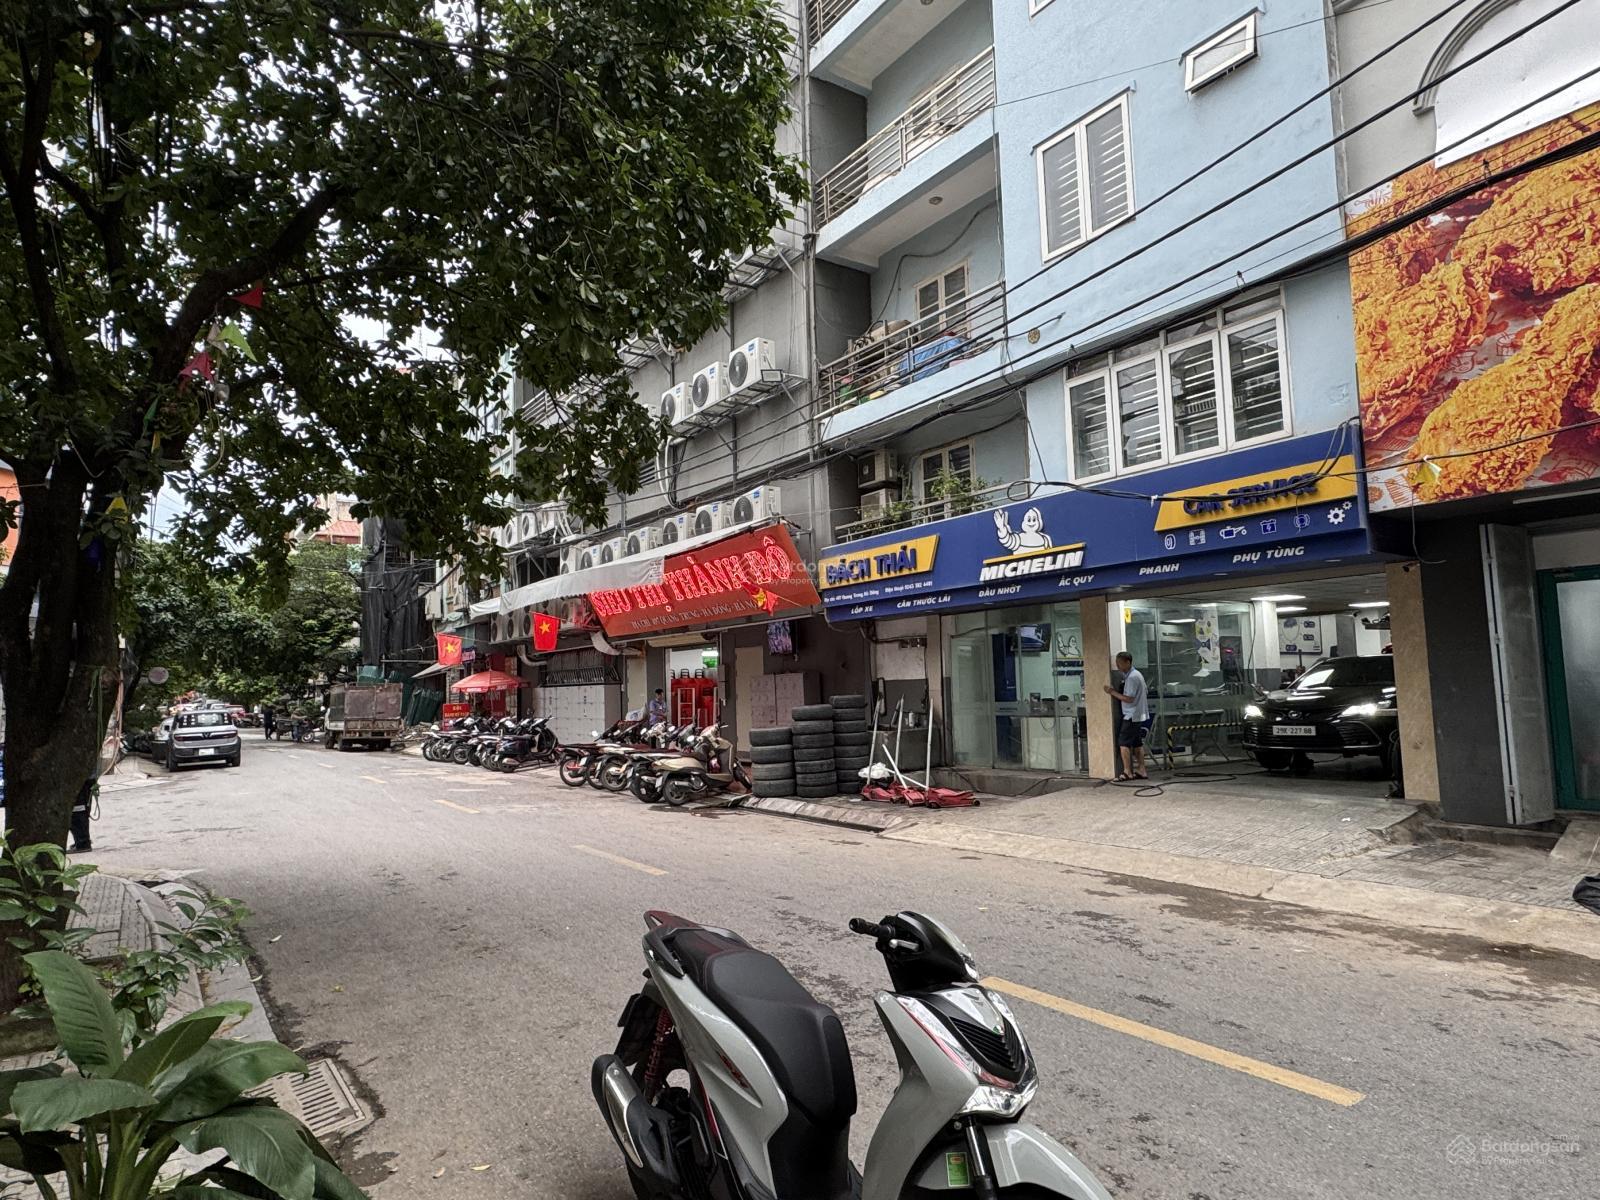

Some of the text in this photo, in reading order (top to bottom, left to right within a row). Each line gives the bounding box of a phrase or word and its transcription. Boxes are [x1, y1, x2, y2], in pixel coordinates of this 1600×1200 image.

[1232, 546, 1304, 564] PHỤ TÙNG
[664, 556, 748, 601] THÀNH
[745, 536, 791, 585] ĐÔ
[979, 550, 1084, 581] MICHELIN
[1139, 563, 1179, 576] PHANH
[1073, 575, 1095, 586] QUY
